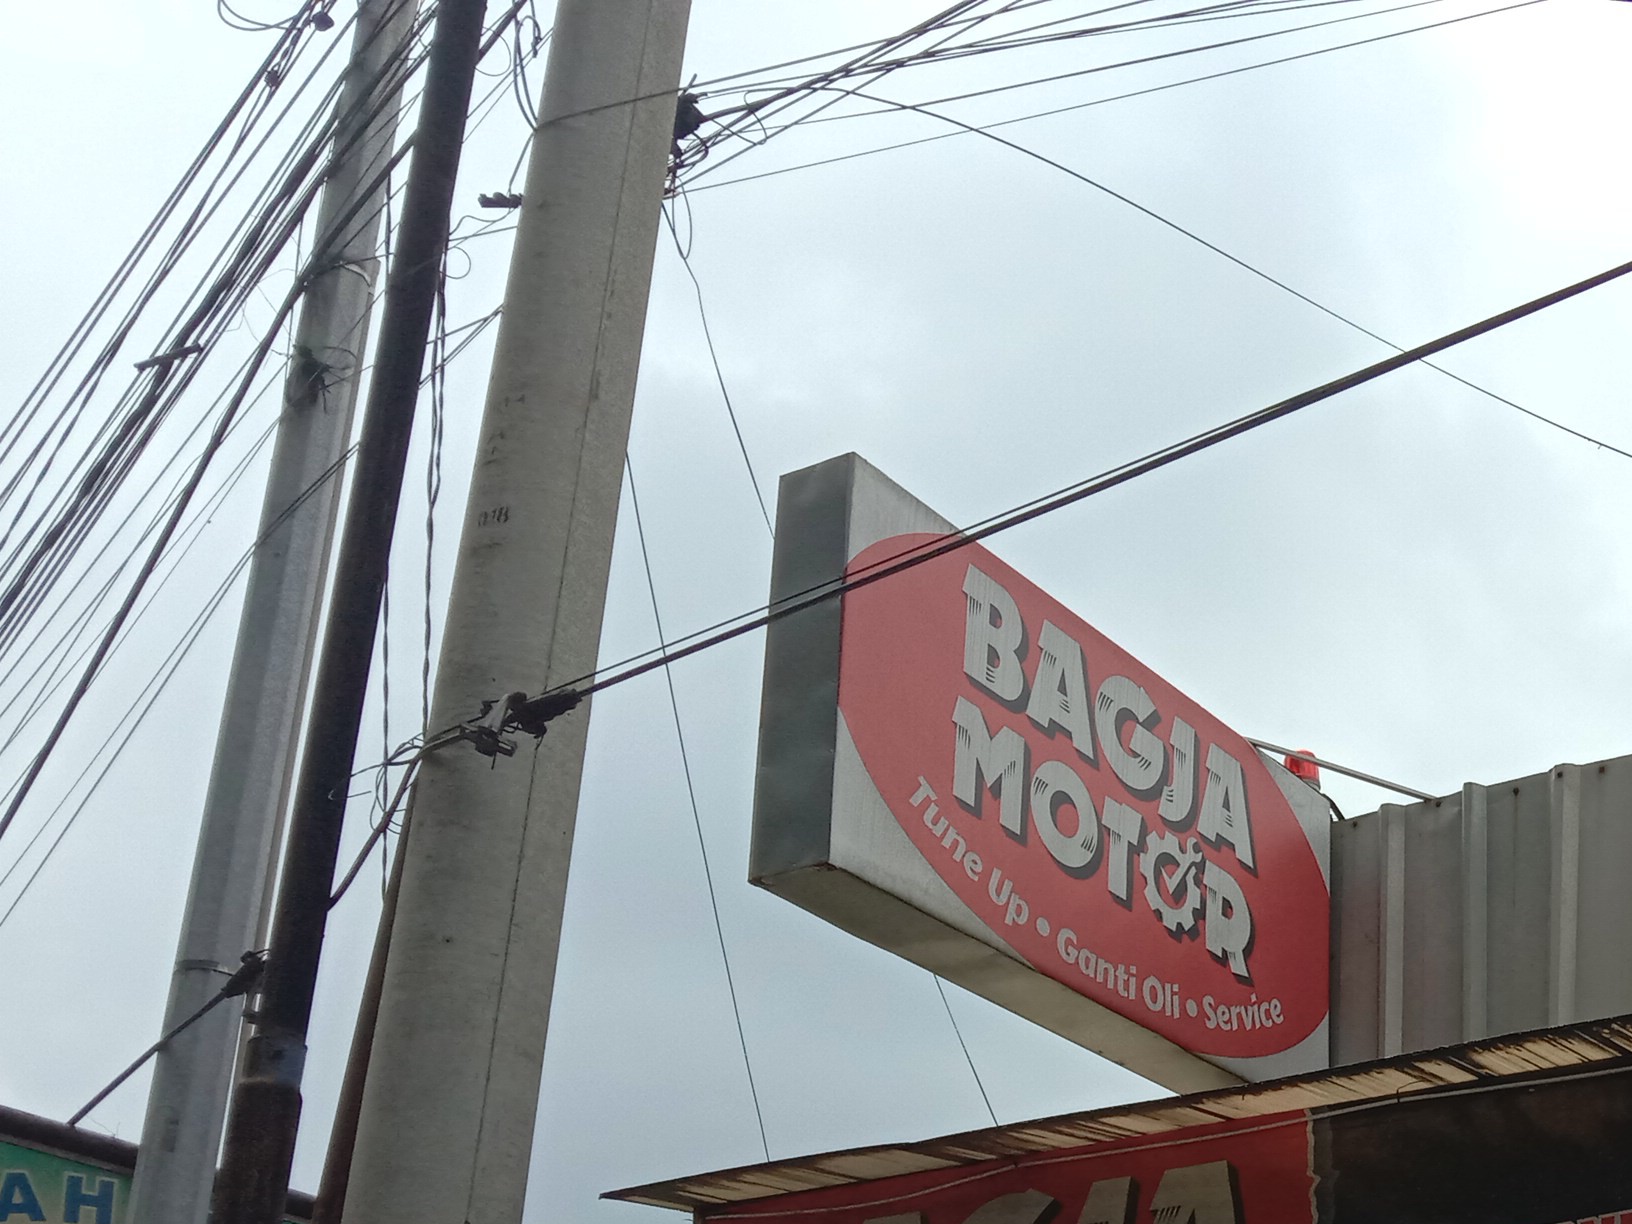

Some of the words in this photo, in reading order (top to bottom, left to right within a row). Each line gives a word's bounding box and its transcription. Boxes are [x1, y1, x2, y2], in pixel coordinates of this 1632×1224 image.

[952, 695, 1253, 982] MOTOR
[961, 563, 1257, 874] BAGJA
[909, 776, 982, 882] Tune
[988, 870, 1029, 926] Up
[1057, 928, 1137, 1000] Ganti
[1143, 975, 1180, 1019] Oli
[1204, 994, 1284, 1031] Service
